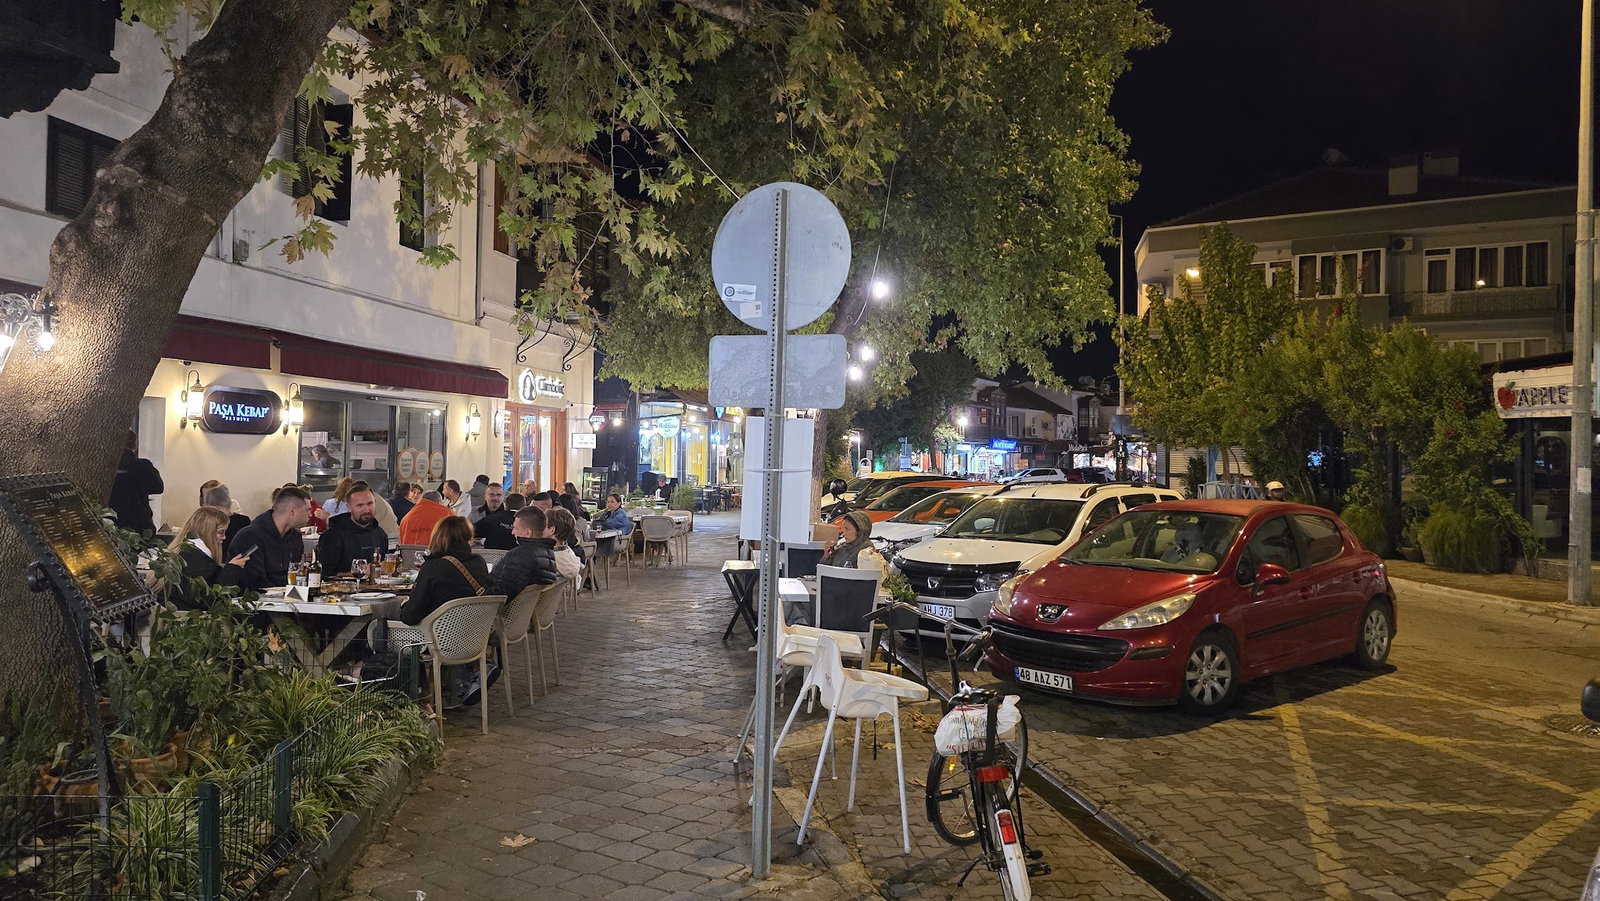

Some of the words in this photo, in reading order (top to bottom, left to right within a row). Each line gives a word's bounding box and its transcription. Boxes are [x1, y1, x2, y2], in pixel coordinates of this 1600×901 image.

[1518, 385, 1568, 407] APPLE
[208, 401, 234, 418] PAŞA
[236, 403, 268, 418] KEBAP
[939, 606, 953, 618] 378
[1020, 668, 1031, 681] 48
[1034, 671, 1051, 685] AAZ
[1053, 675, 1071, 689] 571
